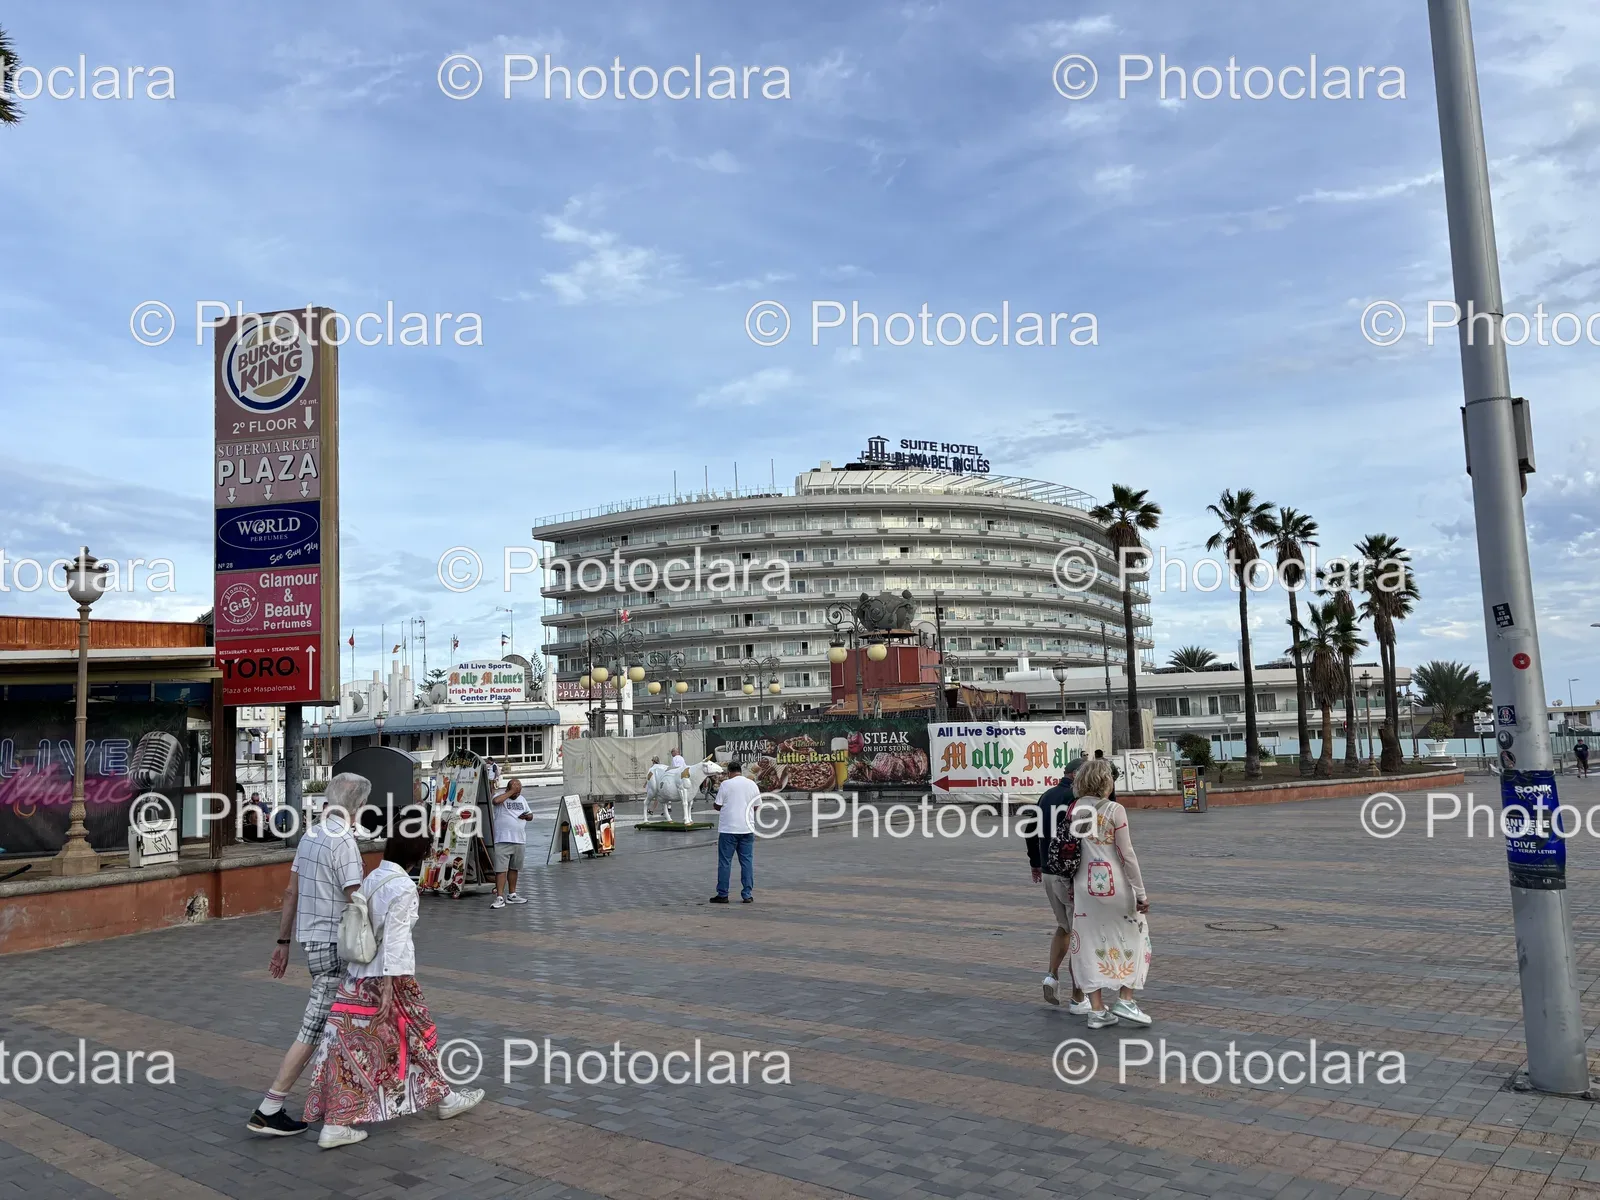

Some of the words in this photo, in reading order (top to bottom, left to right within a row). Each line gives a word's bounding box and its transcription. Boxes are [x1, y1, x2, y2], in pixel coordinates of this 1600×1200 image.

[237, 335, 301, 372] BURGER
[240, 350, 303, 393] KING
[249, 418, 297, 433] FLOOR
[218, 438, 319, 458] SUPERMARKET
[900, 439, 938, 452] SUITE
[941, 442, 983, 456] HOTEL
[218, 453, 319, 486] PLAZA
[931, 454, 951, 470] DEL
[236, 517, 300, 536] WORLD
[250, 534, 288, 542] PERFUMES
[269, 552, 284, 565] See
[285, 548, 302, 559] Buy
[303, 542, 319, 554] Fly
[259, 573, 318, 588] Glamour
[284, 588, 293, 602] &
[264, 602, 313, 619] Beauty
[263, 619, 312, 630] Perfumes
[220, 656, 295, 679] TORO
[448, 672, 478, 687] Molly
[481, 671, 523, 686] Malone's
[254, 685, 296, 693] Maspalomas
[864, 731, 909, 744] STEAK
[937, 728, 953, 737] All
[957, 727, 982, 736] Live
[986, 726, 1026, 738] Sports
[725, 740, 767, 752] BREAKFAST
[1, 738, 132, 777] LIVE
[741, 752, 761, 763] LUNCH
[776, 752, 807, 763] Little
[810, 750, 846, 763] Brasil
[940, 741, 1014, 775] Molly
[977, 776, 1007, 787] Irish
[1011, 776, 1034, 787] Pub
[1514, 785, 1552, 793] SONIK
[1513, 841, 1537, 849] DIVE
